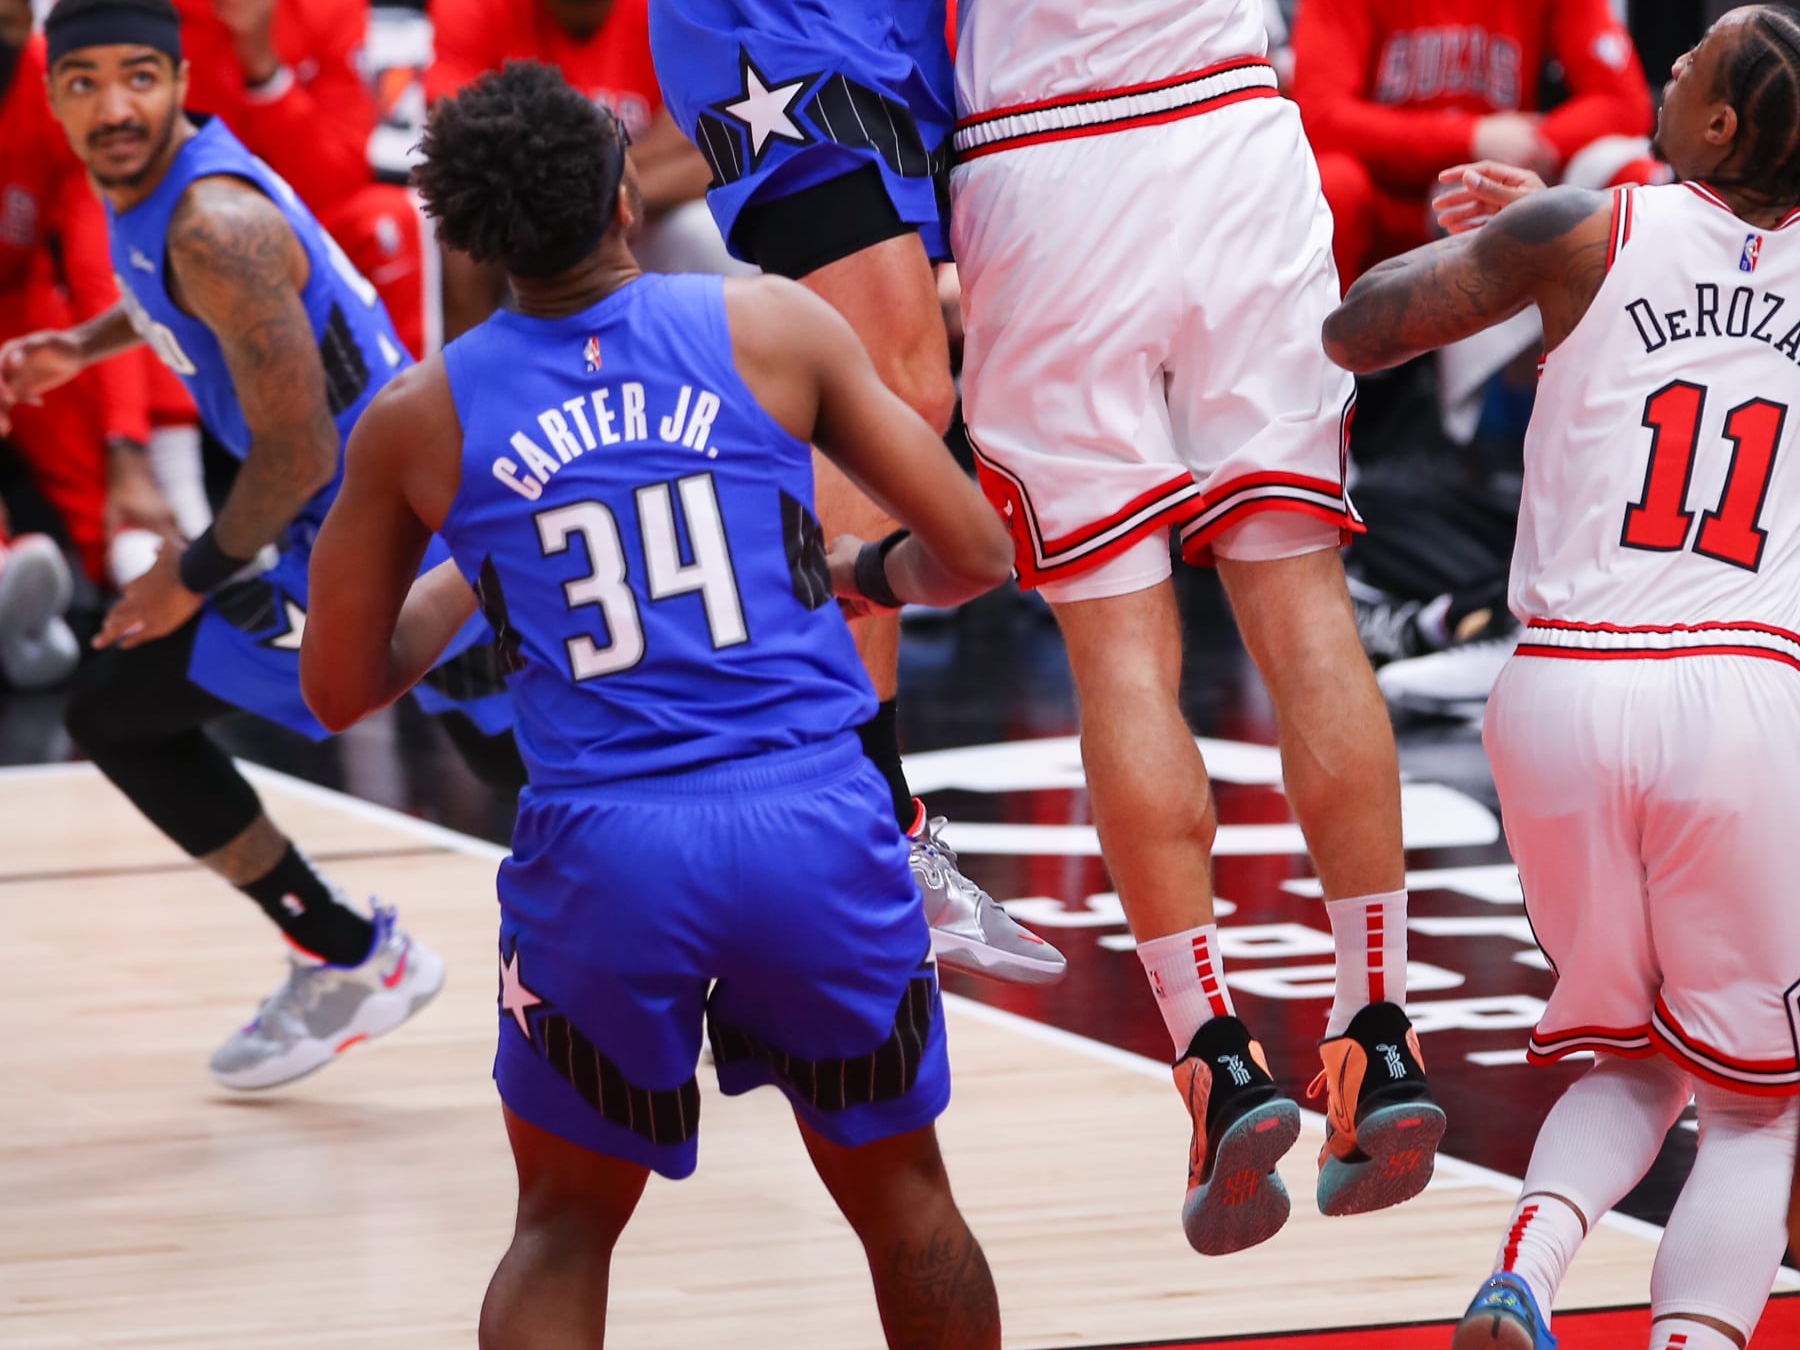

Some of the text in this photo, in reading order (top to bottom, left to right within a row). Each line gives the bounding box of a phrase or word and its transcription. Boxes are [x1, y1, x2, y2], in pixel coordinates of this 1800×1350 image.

[492, 381, 721, 501] CARTER JR.
[1620, 378, 1789, 573] 11
[532, 471, 751, 683] 34
